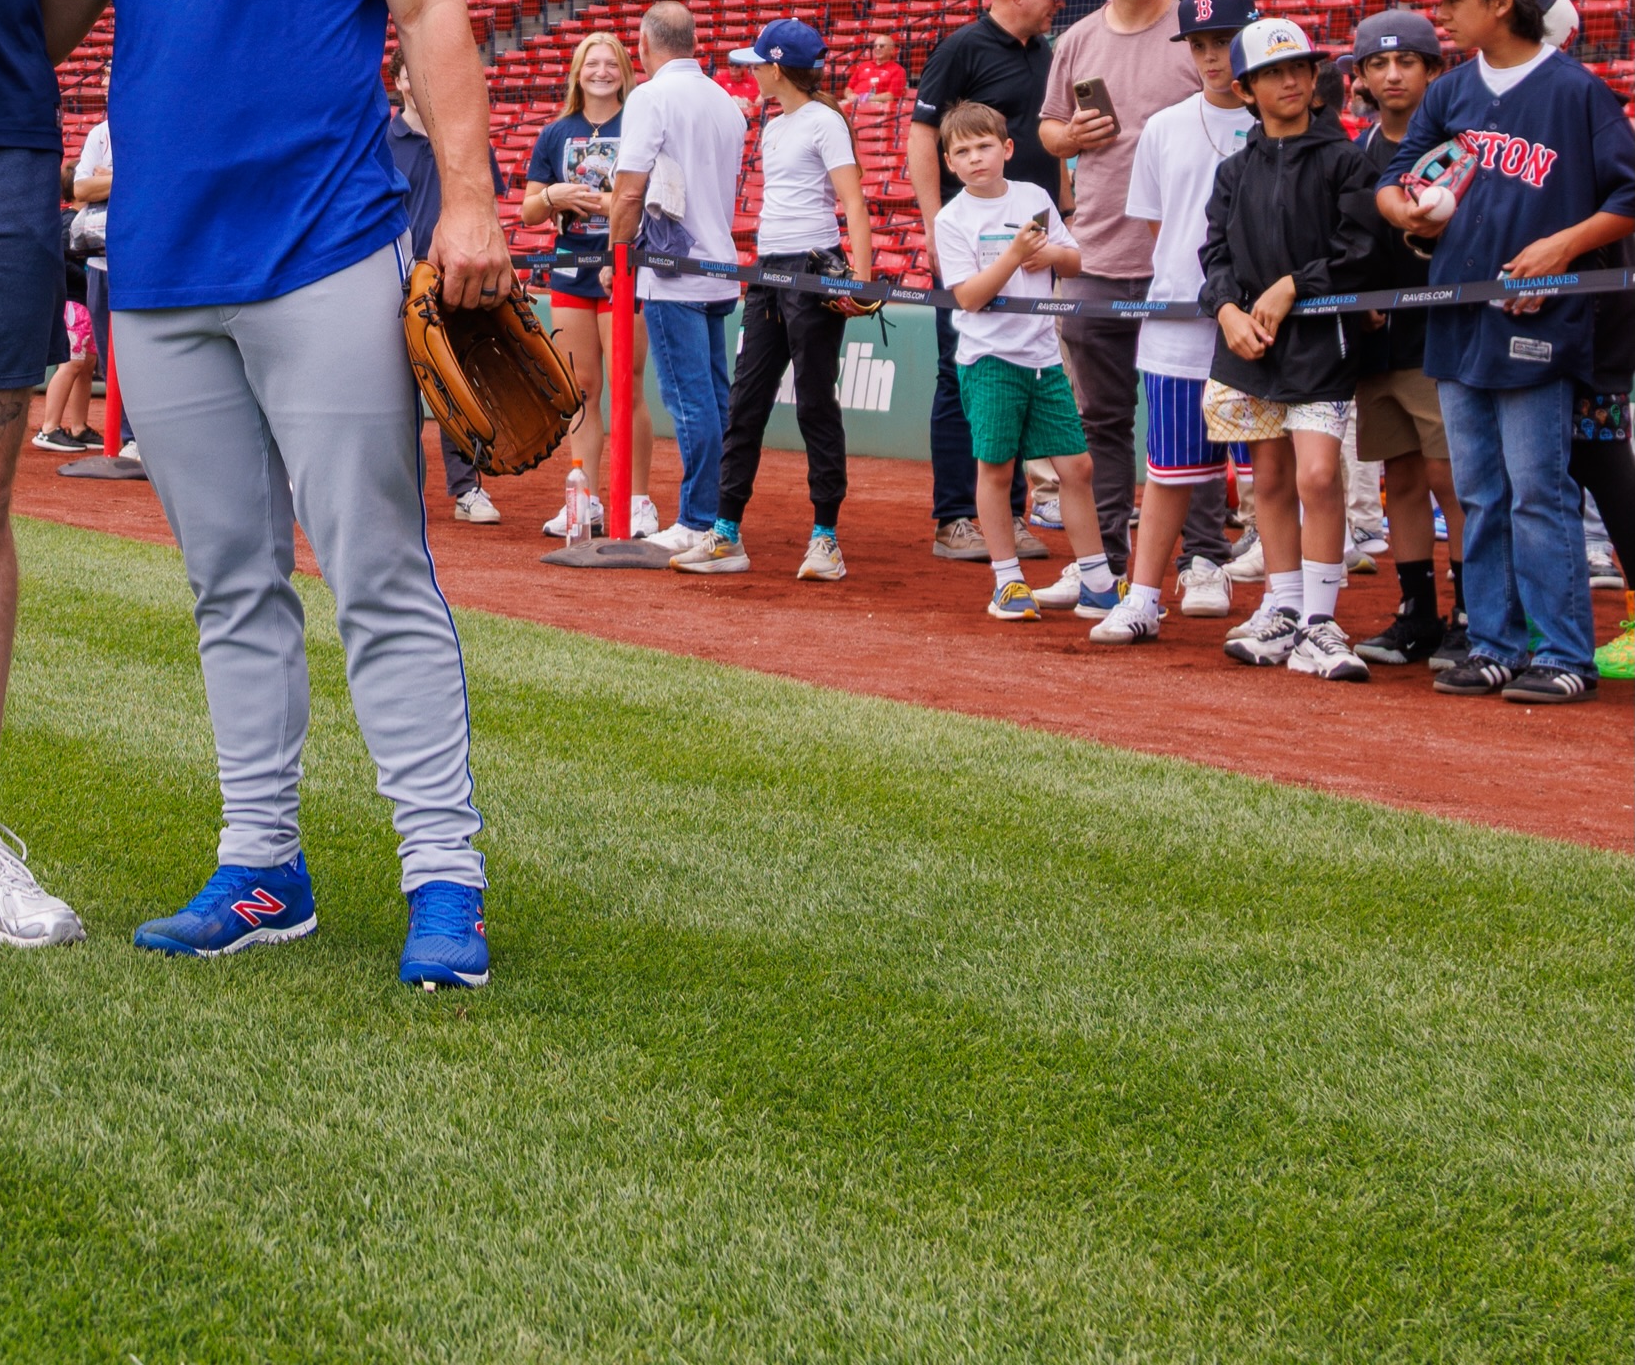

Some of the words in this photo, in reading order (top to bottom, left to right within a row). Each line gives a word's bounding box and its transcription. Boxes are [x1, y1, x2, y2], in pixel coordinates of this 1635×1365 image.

[1458, 129, 1558, 188] STON
[648, 256, 675, 267] RAVEIS.COM
[763, 272, 793, 284] RAVEIS.COM
[1503, 275, 1545, 290] WILLIAM
[1546, 273, 1579, 286] RAVEIS
[891, 289, 925, 301] RAVEIS.COM
[1401, 289, 1453, 303] RAVEIS.COM
[1519, 289, 1536, 297] REAL
[1036, 302, 1076, 312] RAVEIS.COM
